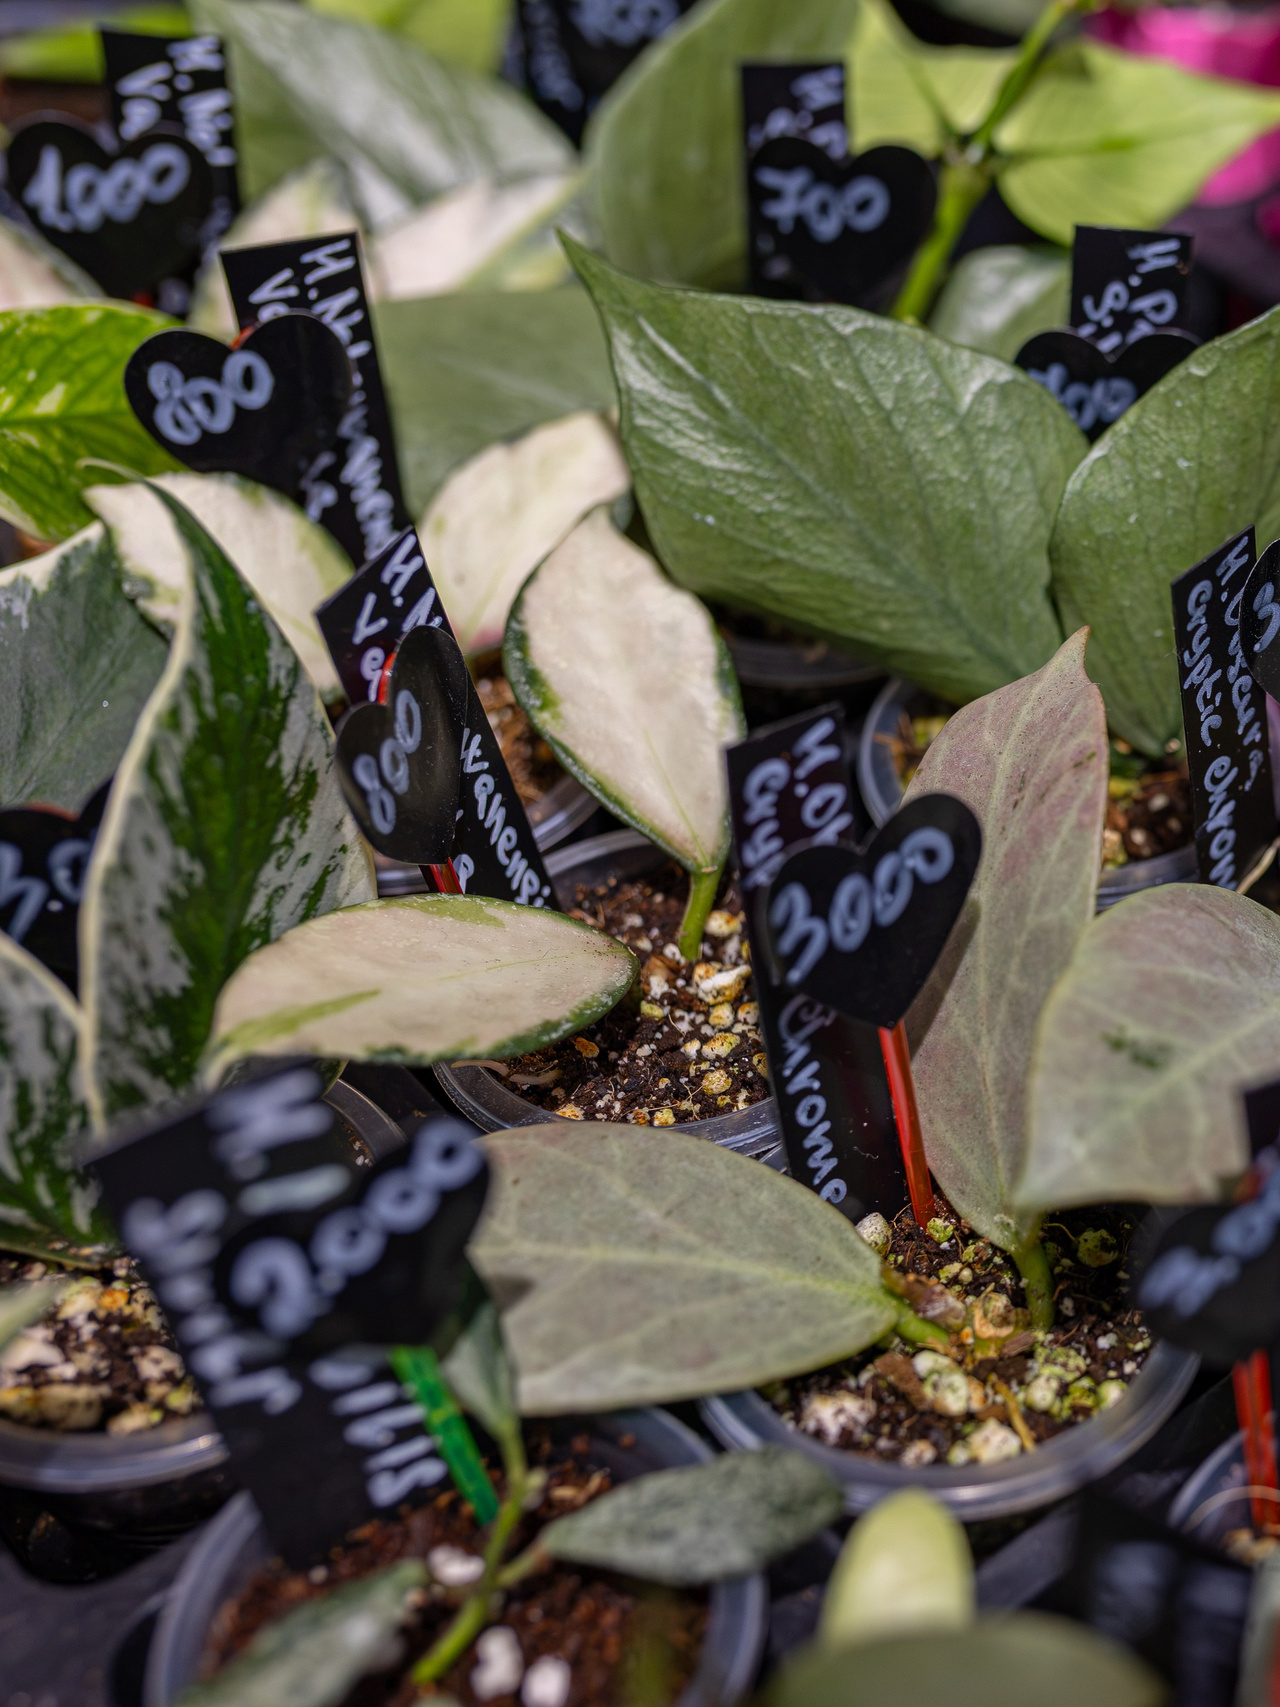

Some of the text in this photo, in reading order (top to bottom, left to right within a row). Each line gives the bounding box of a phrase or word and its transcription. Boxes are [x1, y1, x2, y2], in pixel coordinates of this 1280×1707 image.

[755, 166, 890, 243] 700
[147, 349, 274, 446] 800
[353, 690, 422, 835] 800
[1183, 579, 1239, 892] Cryptic Chrom
[770, 827, 955, 986] 3000
